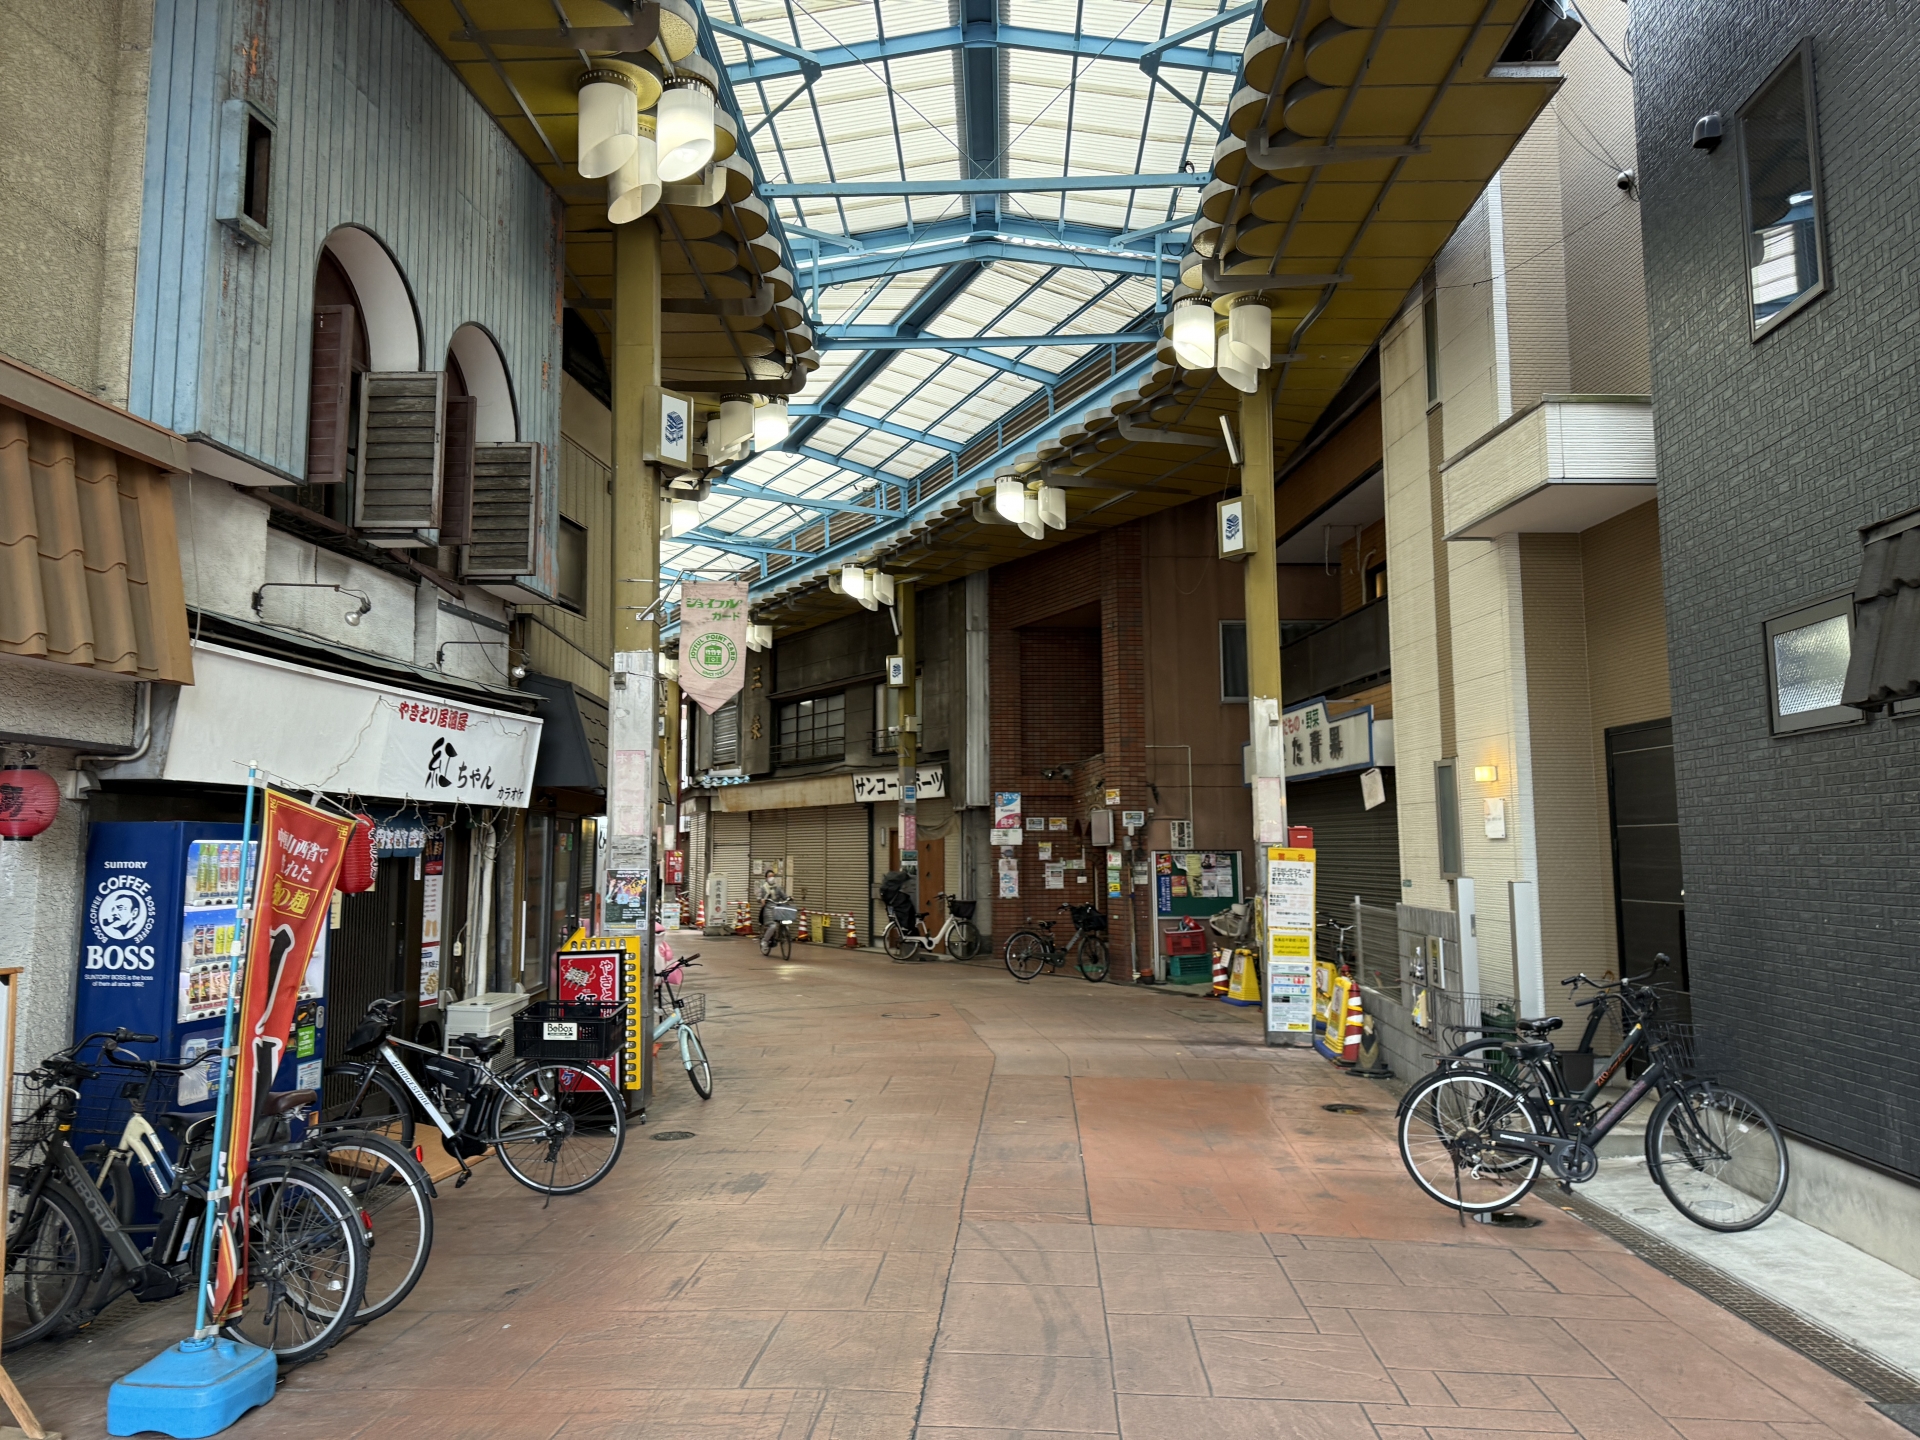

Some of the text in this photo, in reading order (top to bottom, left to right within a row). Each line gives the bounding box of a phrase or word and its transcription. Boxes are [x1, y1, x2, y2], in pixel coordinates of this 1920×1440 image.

[686, 598, 743, 608] ジョイフル
[712, 612, 740, 620] カード
[691, 634, 736, 661] JOYFUL POINT CARD
[399, 701, 469, 731] やきとり居酒屋
[1283, 725, 1343, 767] た青果
[424, 736, 495, 790] 紅ちゃん
[497, 786, 524, 801] カラオケ
[855, 771, 943, 797] サンコーーツ
[104, 861, 148, 869] SUNTORY
[98, 875, 151, 896] COFFEE
[89, 895, 109, 944] BOSS COFFEE
[134, 896, 156, 944] BOSS COFFEE
[85, 945, 155, 970] BOSS
[547, 1023, 574, 1033] BeBox
[391, 1060, 430, 1107] BRIDGESTONE
